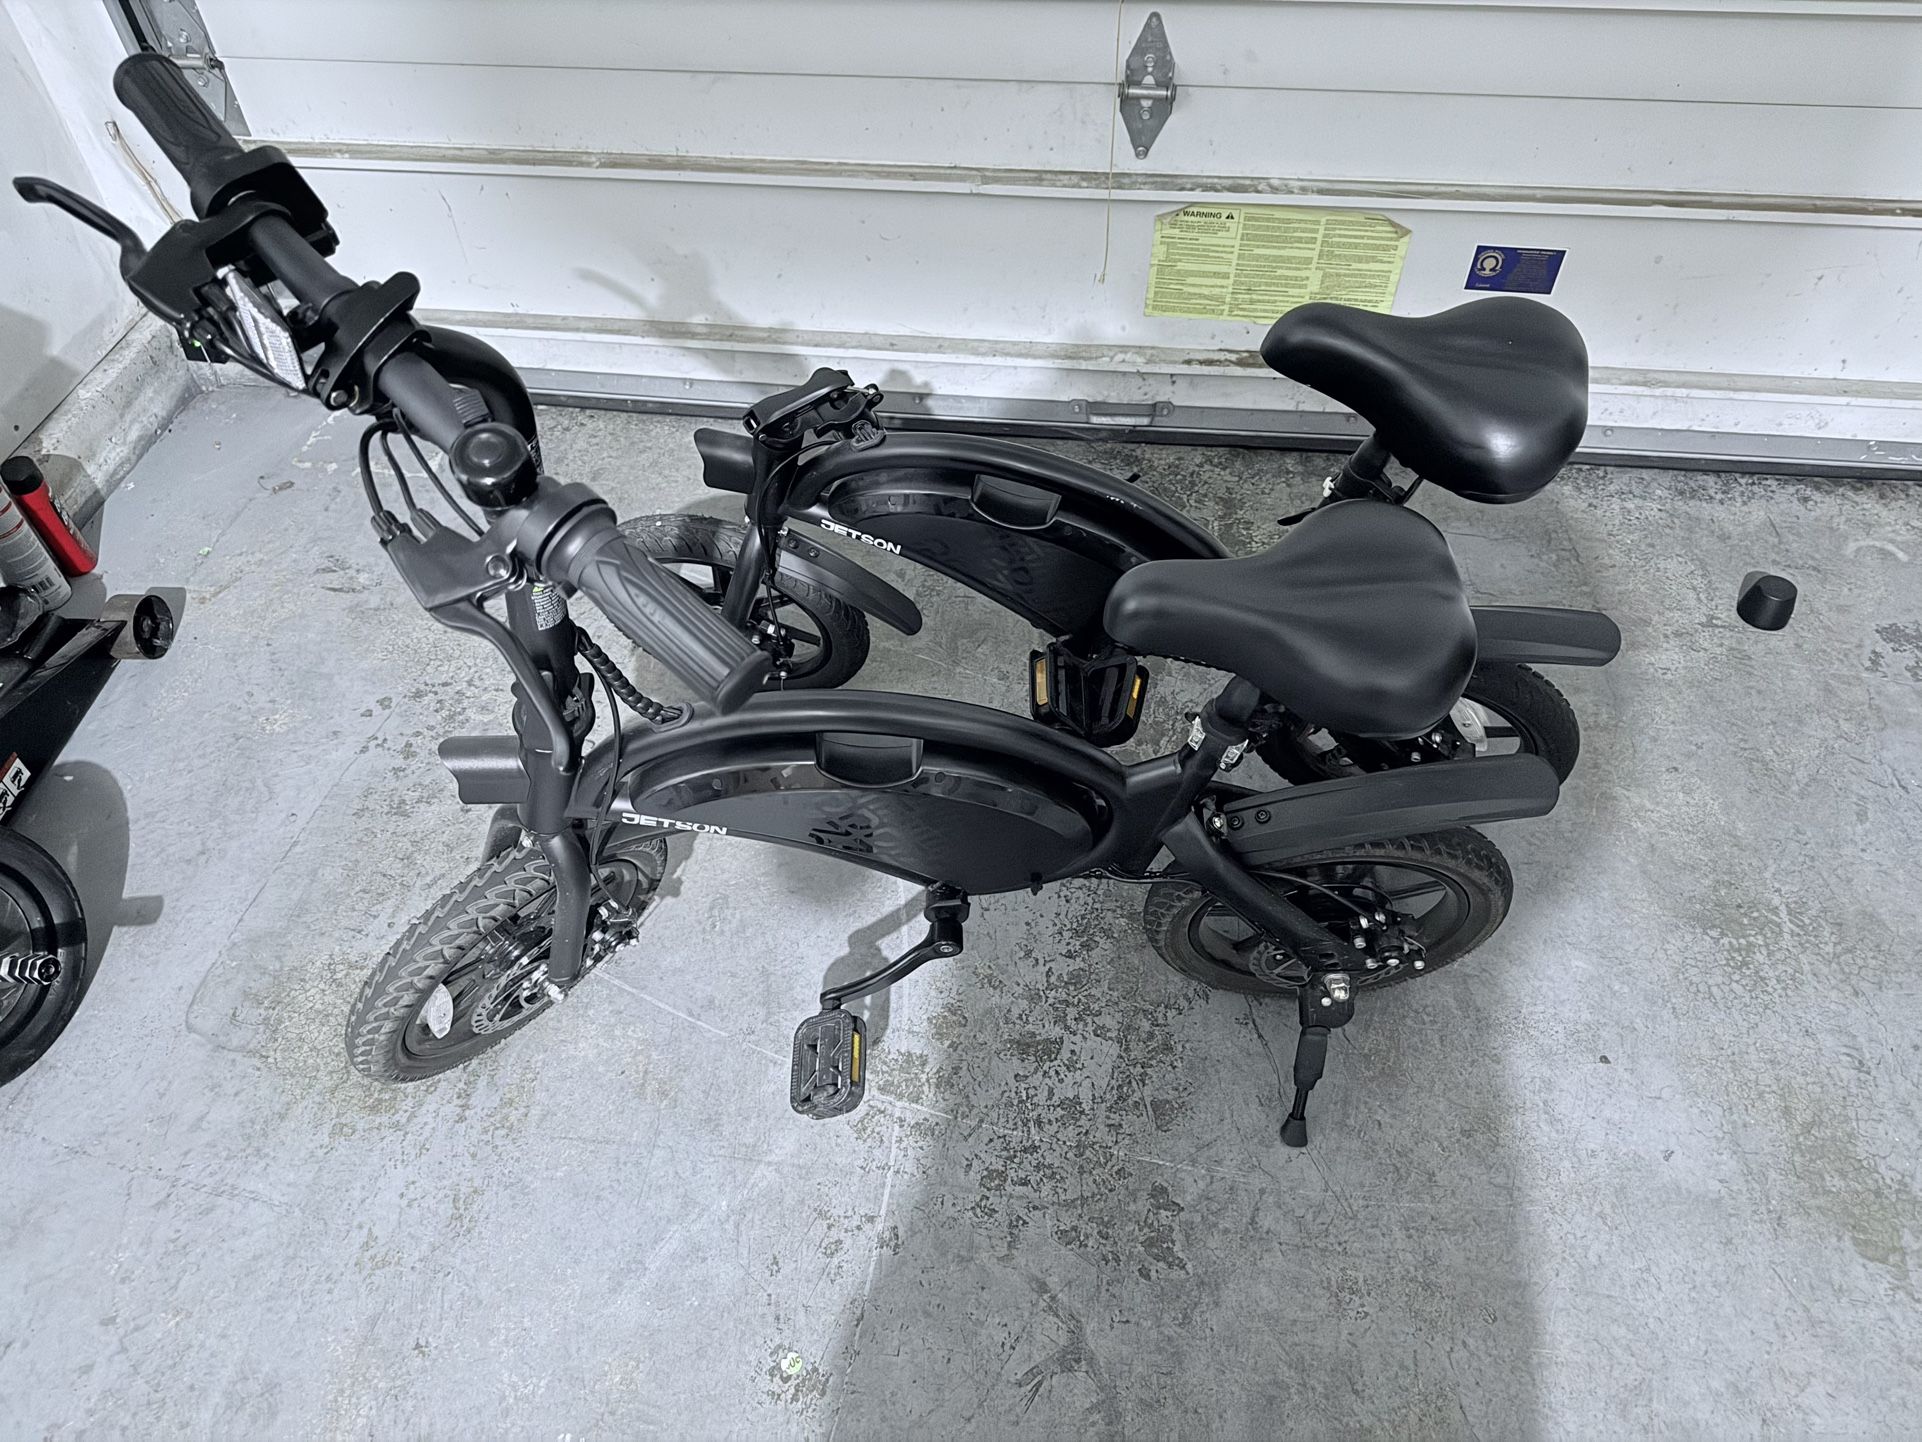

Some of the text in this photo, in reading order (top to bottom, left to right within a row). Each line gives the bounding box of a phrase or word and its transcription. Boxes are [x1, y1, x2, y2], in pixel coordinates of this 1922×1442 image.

[1183, 210, 1222, 219] WARNING
[820, 518, 902, 555] JETSON
[621, 812, 728, 835] JETSON
